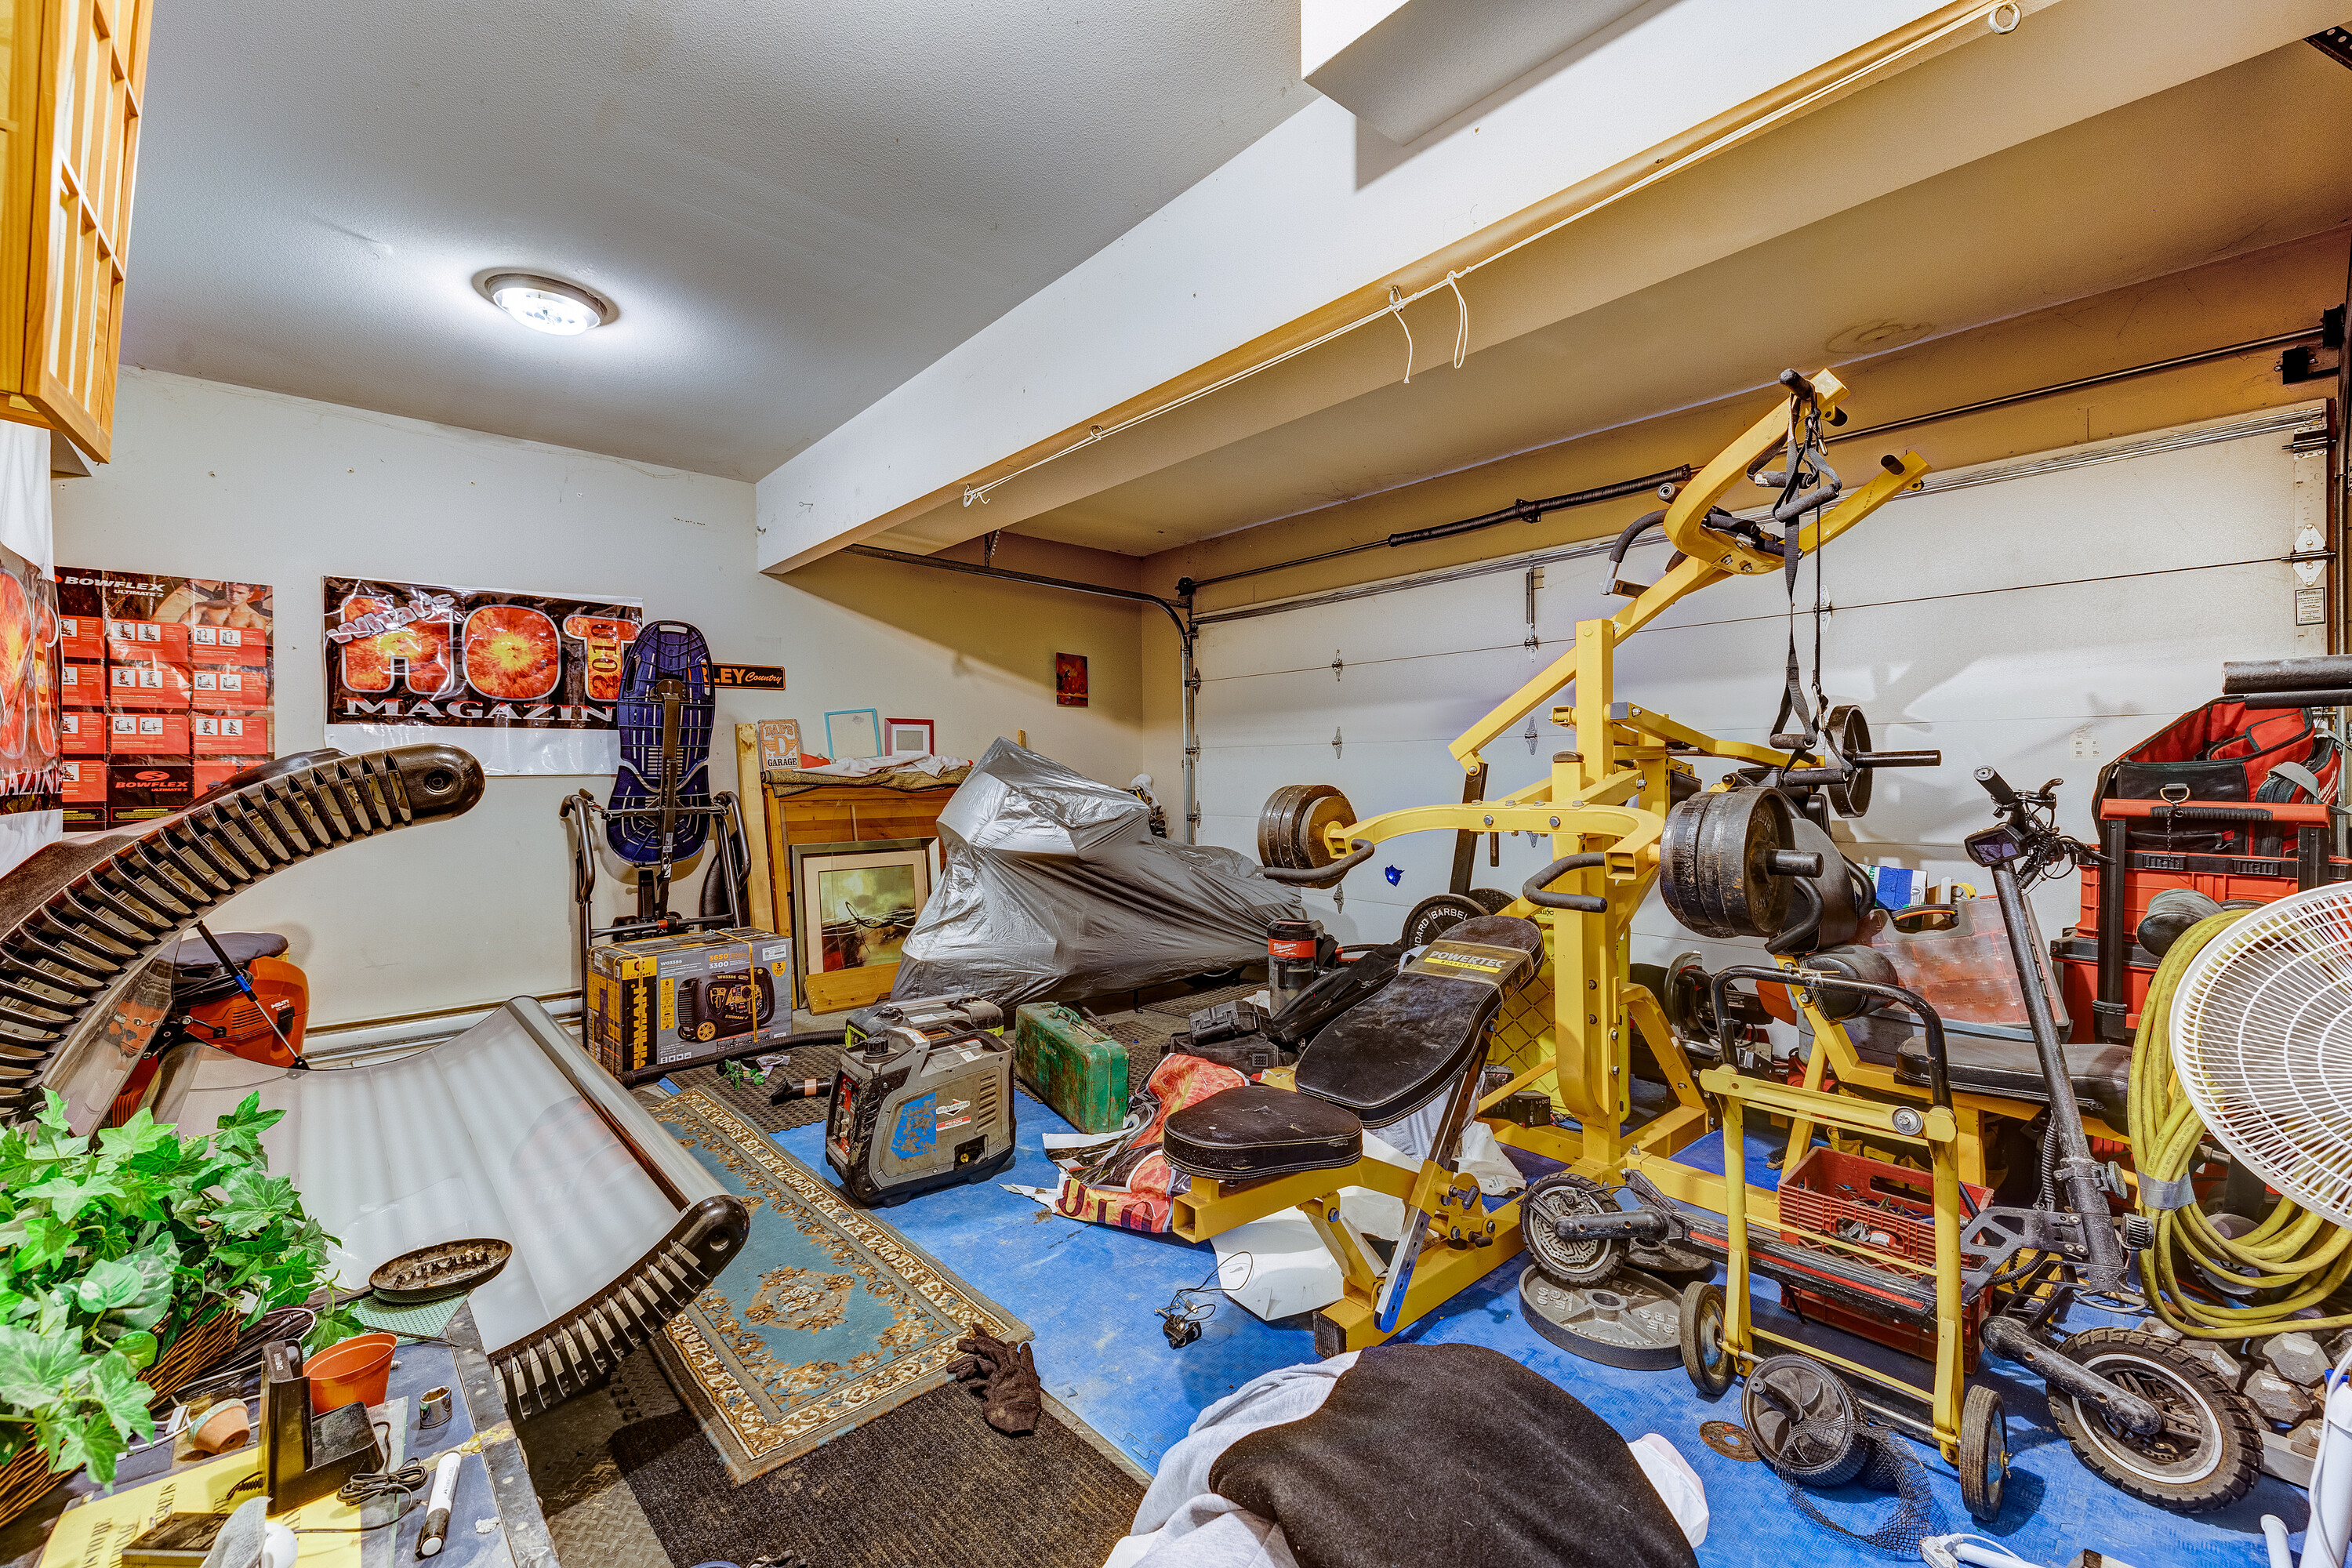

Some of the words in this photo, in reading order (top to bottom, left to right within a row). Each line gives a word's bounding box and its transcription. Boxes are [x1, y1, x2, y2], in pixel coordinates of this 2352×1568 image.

[64, 575, 165, 592] BOWFLEX
[325, 593, 455, 644] What's
[591, 623, 620, 690] 2010
[745, 671, 782, 684] Country
[342, 696, 615, 722] MAGAZIN
[764, 724, 793, 736] DAD'S
[768, 758, 797, 767] GARAGE
[1431, 908, 1469, 921] BARBEL
[1273, 942, 1297, 951] Milwaukee
[1428, 950, 1506, 968] POWERTEC
[1441, 960, 1481, 970] WORKBENCH
